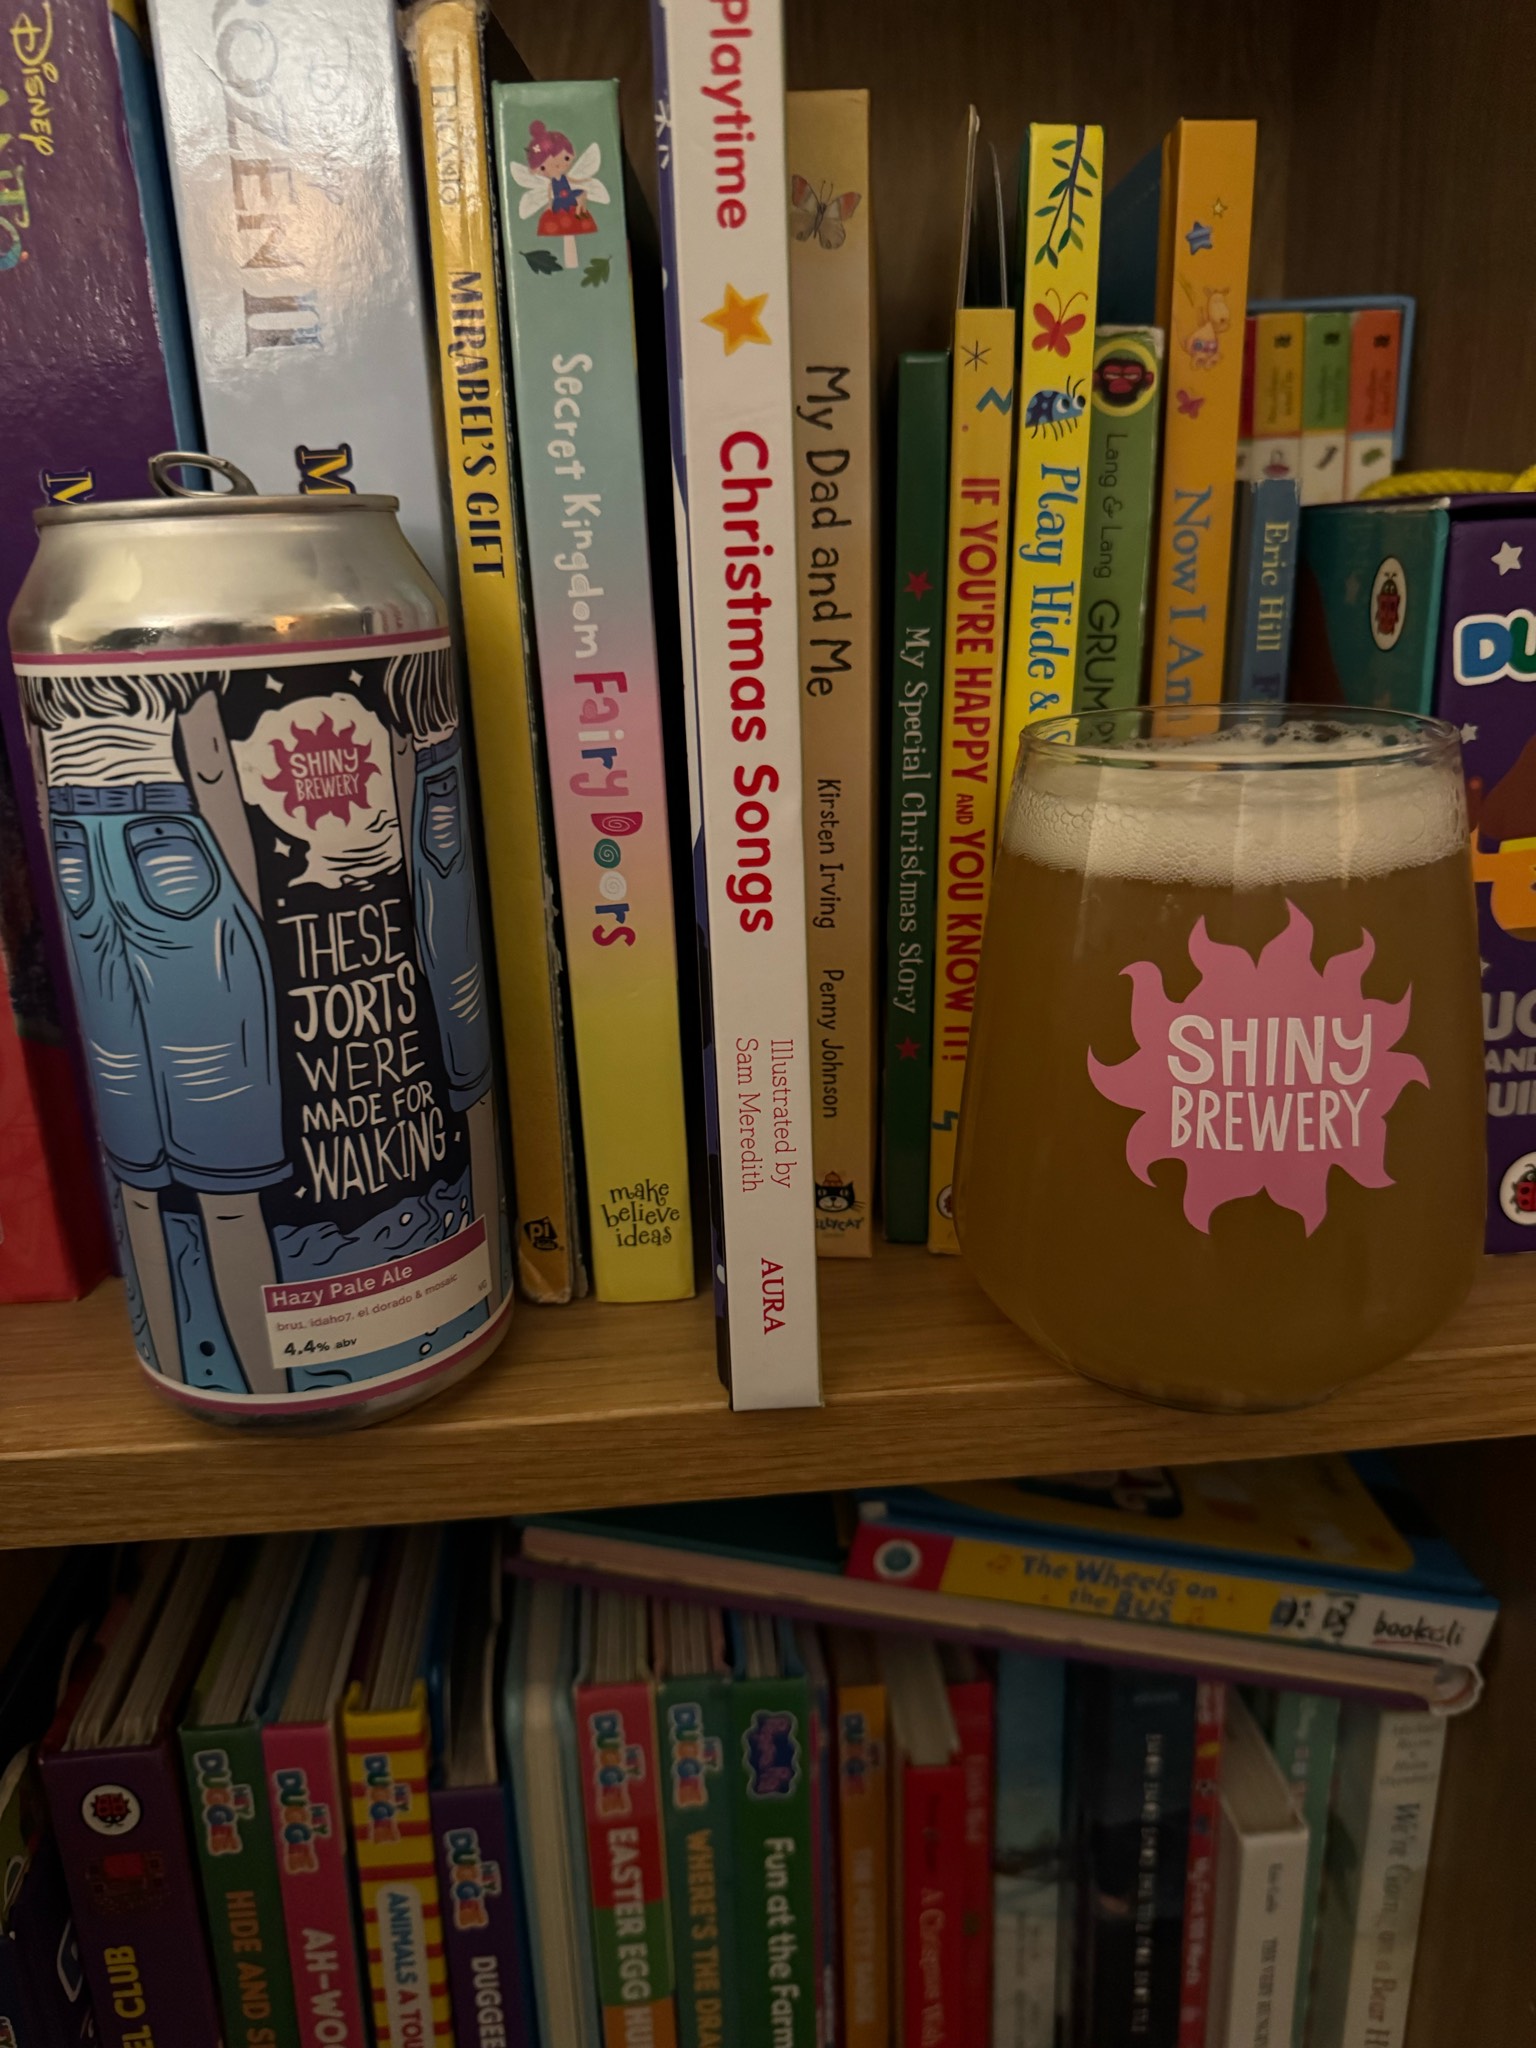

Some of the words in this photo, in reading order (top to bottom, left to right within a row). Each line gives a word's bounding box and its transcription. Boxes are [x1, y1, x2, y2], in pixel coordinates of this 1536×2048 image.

[9, 1, 59, 156] Disney
[213, 0, 307, 270] OZEN
[447, 271, 497, 476] MIRABEL'S
[796, 366, 850, 430] My
[547, 353, 593, 481] Secret
[806, 449, 851, 530] Dad
[961, 478, 1000, 505] IF
[1100, 433, 1128, 488] Lang
[463, 490, 506, 580] GIFT
[1019, 462, 1081, 566] Play
[1103, 496, 1125, 516] &
[1093, 524, 1122, 580] Lang
[1170, 485, 1212, 596] Now
[1259, 521, 1290, 584] Eric
[554, 493, 605, 659] Kingdom
[719, 431, 774, 742] Christmas
[808, 546, 852, 622] and
[956, 520, 1000, 655] YOU'RE
[1027, 581, 1075, 680] Hide
[1168, 605, 1207, 623] I
[1256, 595, 1287, 653] Hill
[806, 638, 852, 697] Me
[899, 627, 930, 669] My
[569, 671, 629, 797] Fairy
[899, 681, 931, 781] Special
[951, 667, 994, 785] HAPPY
[1029, 691, 1060, 714] &
[289, 747, 360, 780] SHINY
[295, 772, 360, 801] BREWERY
[817, 778, 842, 855] Kirsten
[955, 793, 974, 825] AND
[591, 811, 643, 947] Doors
[726, 765, 779, 932] Songs
[898, 791, 930, 933] Christmas
[947, 829, 986, 901] YOU
[813, 863, 844, 929] Irving
[277, 899, 405, 979] THESE
[944, 912, 982, 1012] KNOW
[288, 960, 417, 1041] JORTS
[817, 969, 845, 1031] Penny
[893, 943, 925, 1013] Story
[296, 1030, 425, 1092] WERE
[735, 1037, 759, 1085] Sam
[821, 1038, 845, 1118] Johnson
[1167, 1013, 1372, 1086] SHINY
[302, 1093, 387, 1133] MADE
[393, 1080, 435, 1118] FOR
[770, 1039, 797, 1155] Illustrated
[1170, 1086, 1371, 1152] BREWERY
[301, 1106, 446, 1203] WALKING
[738, 1093, 764, 1193] Meredith
[770, 1158, 797, 1189] by
[601, 1204, 680, 1227] believe
[610, 1178, 669, 1206] make
[616, 1225, 672, 1247] ideas
[271, 1287, 325, 1307] Hazy
[330, 1278, 375, 1299] Pale
[381, 1265, 413, 1287] Ale
[357, 1307, 369, 1318] el
[373, 1294, 413, 1314] dorado
[415, 1290, 422, 1299] &
[425, 1273, 458, 1297] mosaic
[761, 1257, 786, 1335] AURA
[283, 1340, 330, 1356] 4.4%
[336, 1338, 357, 1350] abv
[1020, 1553, 1067, 1580] The
[1075, 1555, 1178, 1597] Wheels
[1185, 1580, 1218, 1601] on
[1068, 1588, 1109, 1611] the
[1114, 1593, 1174, 1625] BUS
[1389, 1802, 1421, 1856] We're
[607, 1827, 647, 1937] EASTER
[685, 1829, 719, 1940] WHERE'S
[764, 1837, 795, 1892] Fun
[226, 1891, 262, 1953] HIDE
[388, 1892, 418, 1985] ANIMALS
[766, 1895, 796, 1927] at
[104, 1945, 147, 2019] CLUB
[302, 1928, 348, 2048] AH-WO
[615, 1943, 652, 2001] EGG
[693, 1946, 721, 1992] THE
[768, 1934, 799, 1980] the
[236, 1962, 272, 2020] AND
[402, 1991, 419, 2006] A
[770, 1984, 800, 2048] Farm
[1368, 1978, 1398, 2023] Bear
